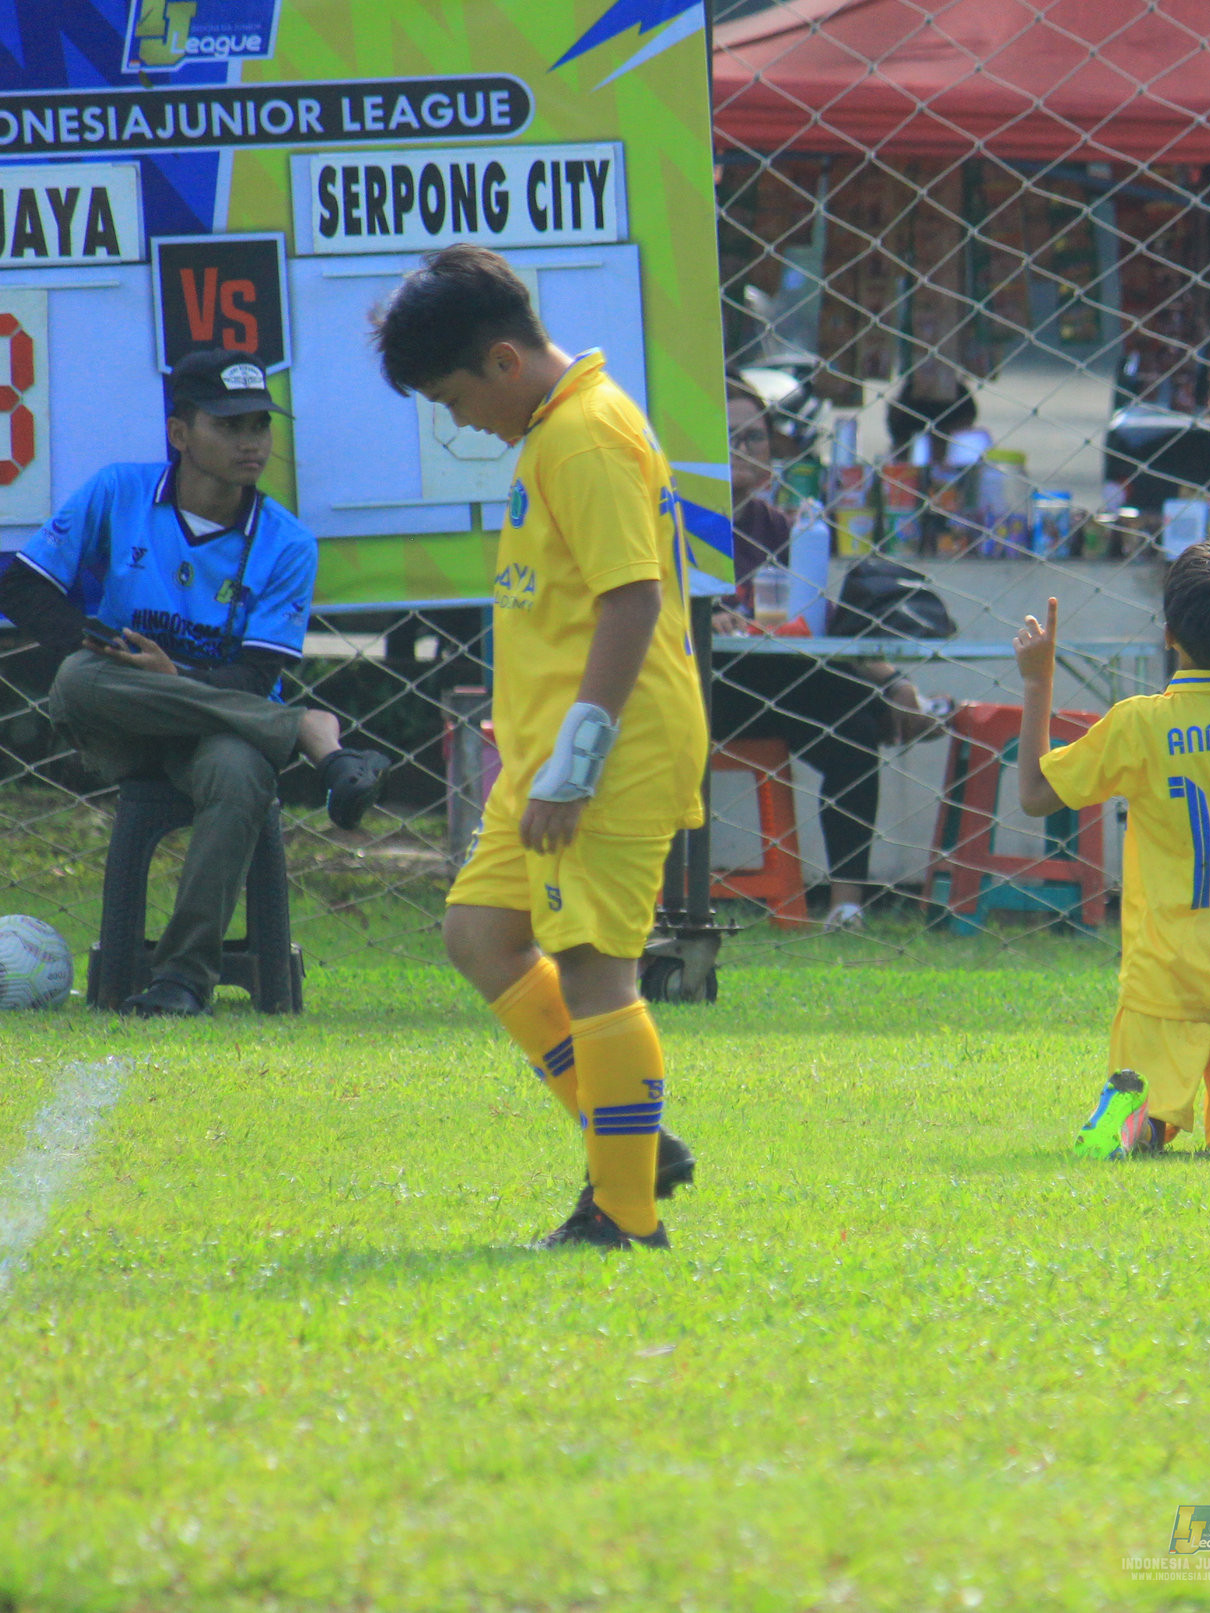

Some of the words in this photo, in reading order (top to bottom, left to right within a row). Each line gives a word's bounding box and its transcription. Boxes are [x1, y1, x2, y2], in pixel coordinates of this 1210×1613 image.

[171, 31, 262, 58] League
[341, 90, 512, 133] LEAGUE
[0, 186, 121, 258] AYA
[318, 160, 510, 239] SERPONG
[527, 159, 611, 233] CITY
